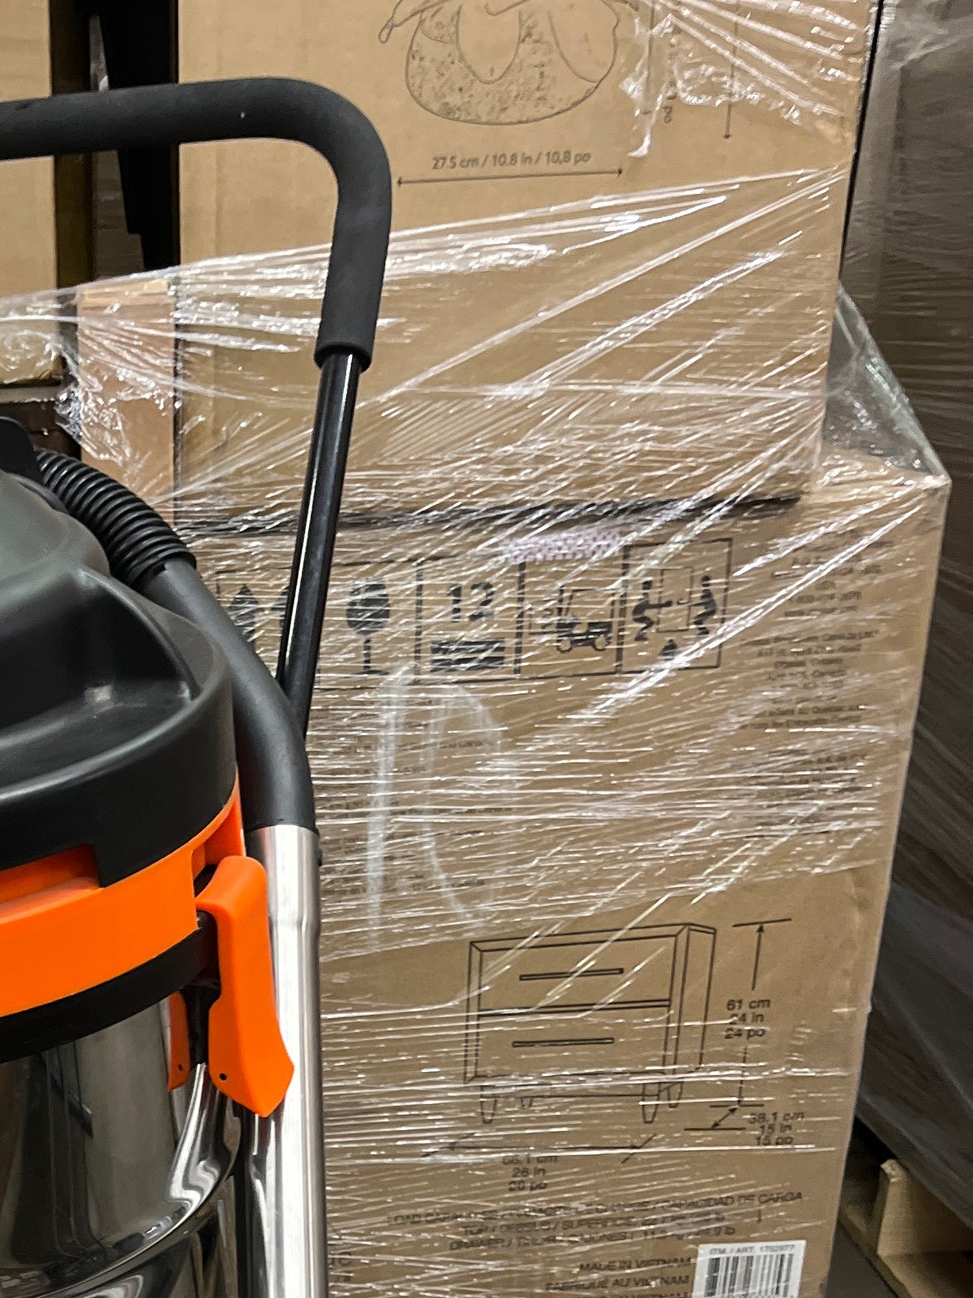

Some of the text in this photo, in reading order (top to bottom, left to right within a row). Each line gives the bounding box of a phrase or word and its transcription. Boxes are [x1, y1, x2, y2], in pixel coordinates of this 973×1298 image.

[459, 157, 480, 169] cm
[520, 152, 533, 165] in
[573, 152, 592, 167] po
[445, 582, 496, 623] 12
[726, 998, 771, 1011] 61 cm
[751, 1011, 765, 1024] in
[724, 1027, 766, 1041] 24 po
[782, 1110, 805, 1122] cm
[779, 1121, 793, 1133] in
